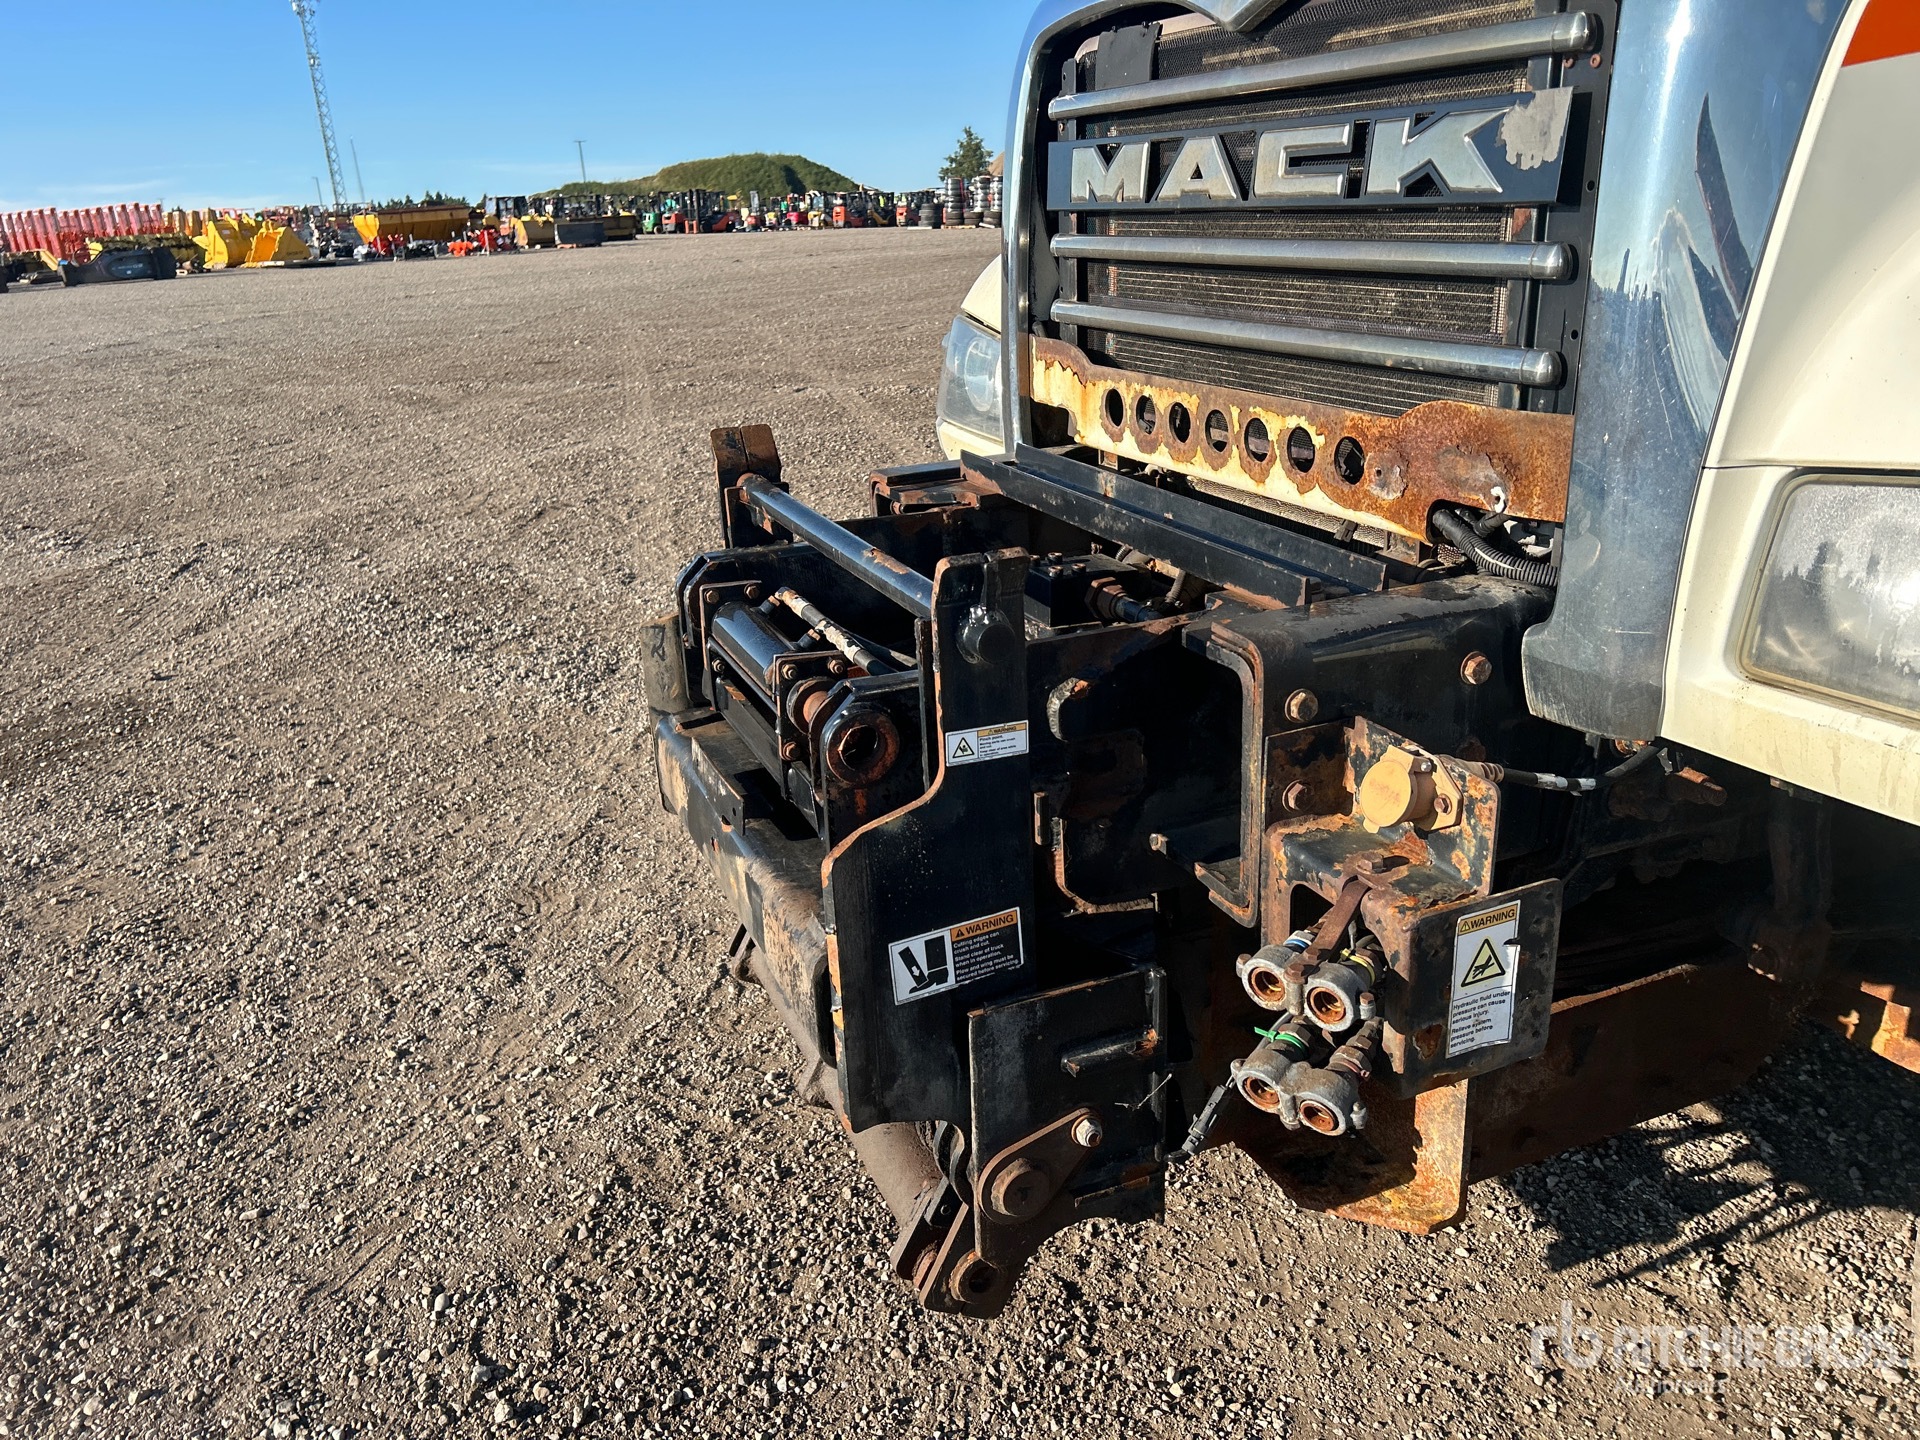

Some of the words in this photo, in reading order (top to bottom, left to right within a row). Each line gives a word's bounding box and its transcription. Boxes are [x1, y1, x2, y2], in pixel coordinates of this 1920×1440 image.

[1070, 107, 1510, 203] MACK
[966, 914, 1014, 934] WARNING
[1470, 910, 1515, 928] WARNING
[954, 940, 972, 948] Cutting
[977, 951, 1001, 961] operation.
[957, 971, 977, 981] secured
[978, 966, 994, 974] before
[995, 959, 1019, 970] servicing.
[1453, 998, 1478, 1011] Hydraulic
[1479, 993, 1492, 1002] fluid
[1452, 1006, 1476, 1018] pressure
[1452, 1014, 1472, 1024] serious
[1473, 1010, 1490, 1018] injury.
[1450, 1030, 1474, 1042] pressure
[1475, 1025, 1493, 1033] before
[1451, 1024, 1471, 1034] Relieve
[1472, 1018, 1491, 1029] system
[1450, 1037, 1476, 1048] servicing.
